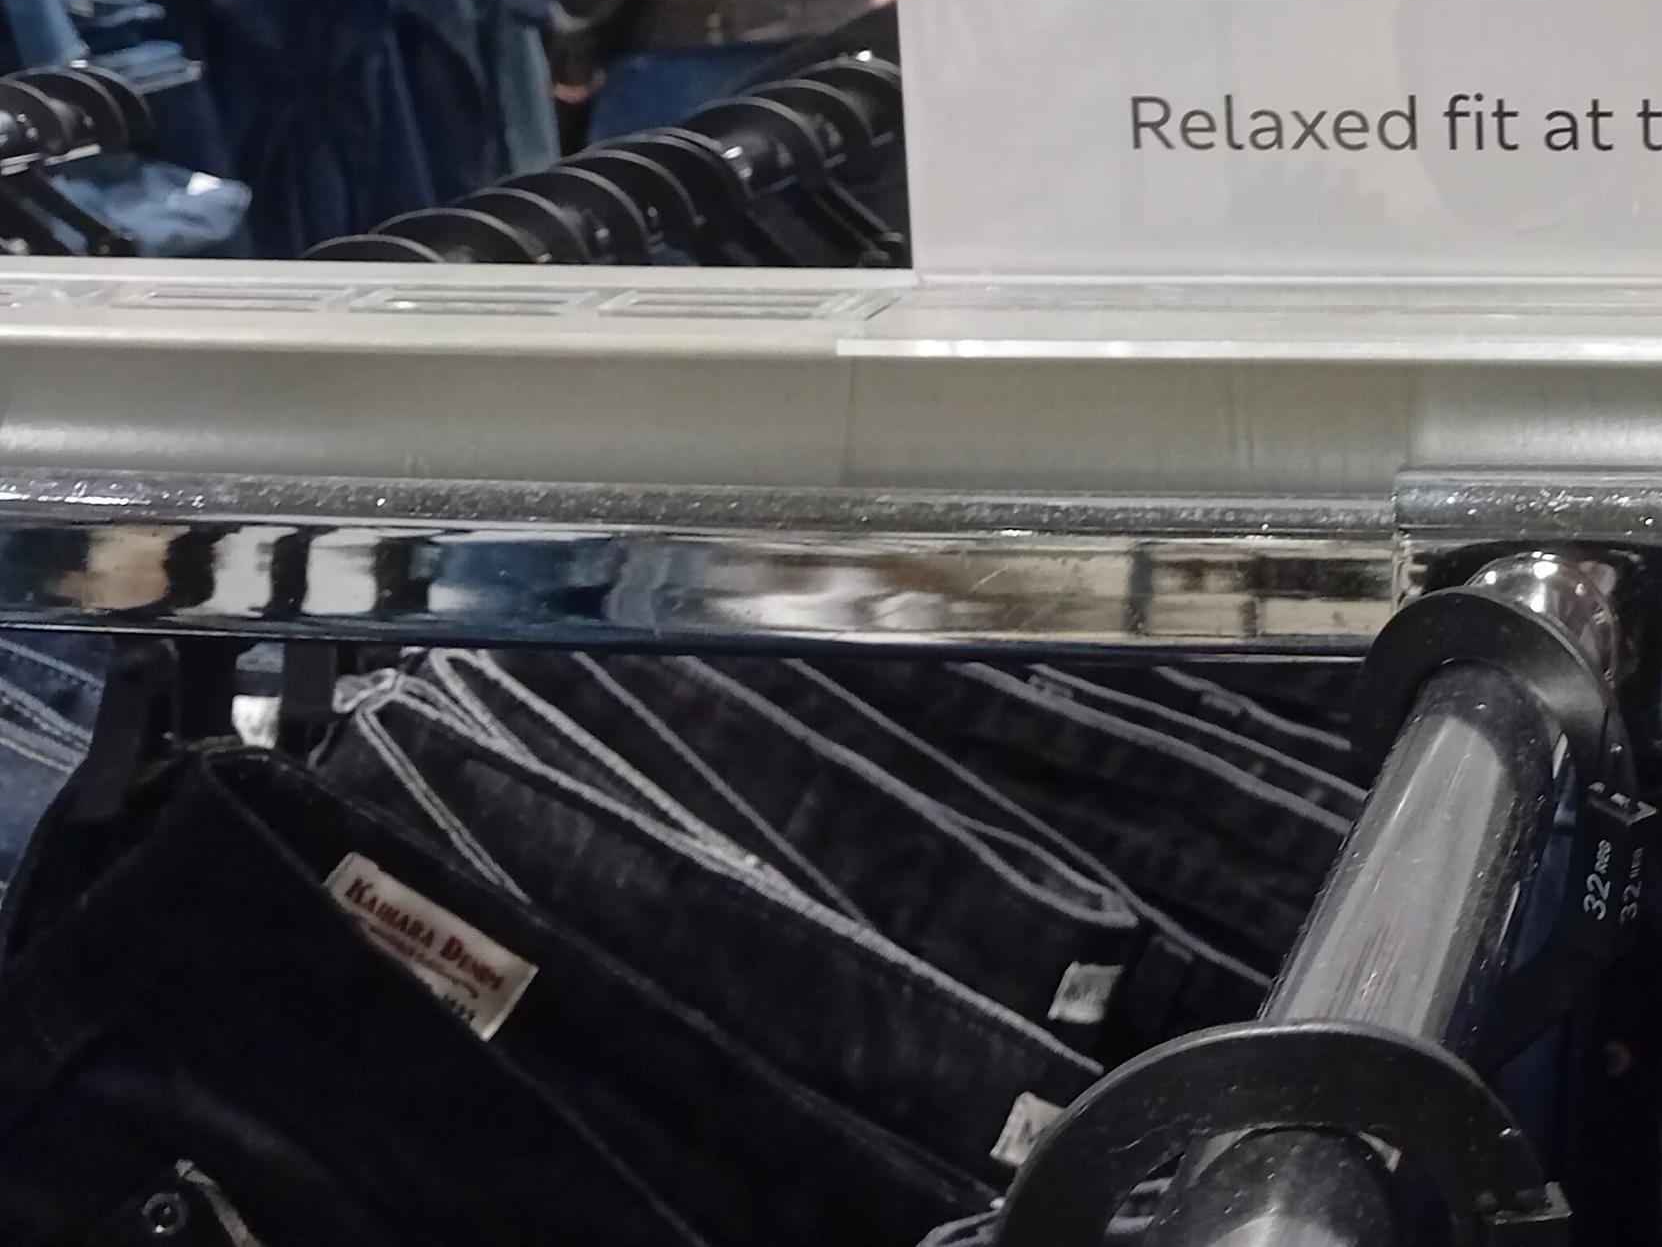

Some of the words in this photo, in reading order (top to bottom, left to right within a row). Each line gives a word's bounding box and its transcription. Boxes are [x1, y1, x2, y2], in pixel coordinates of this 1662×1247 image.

[1131, 94, 1417, 152] Relaxed
[1443, 93, 1519, 152] fit
[1544, 99, 1614, 152] at
